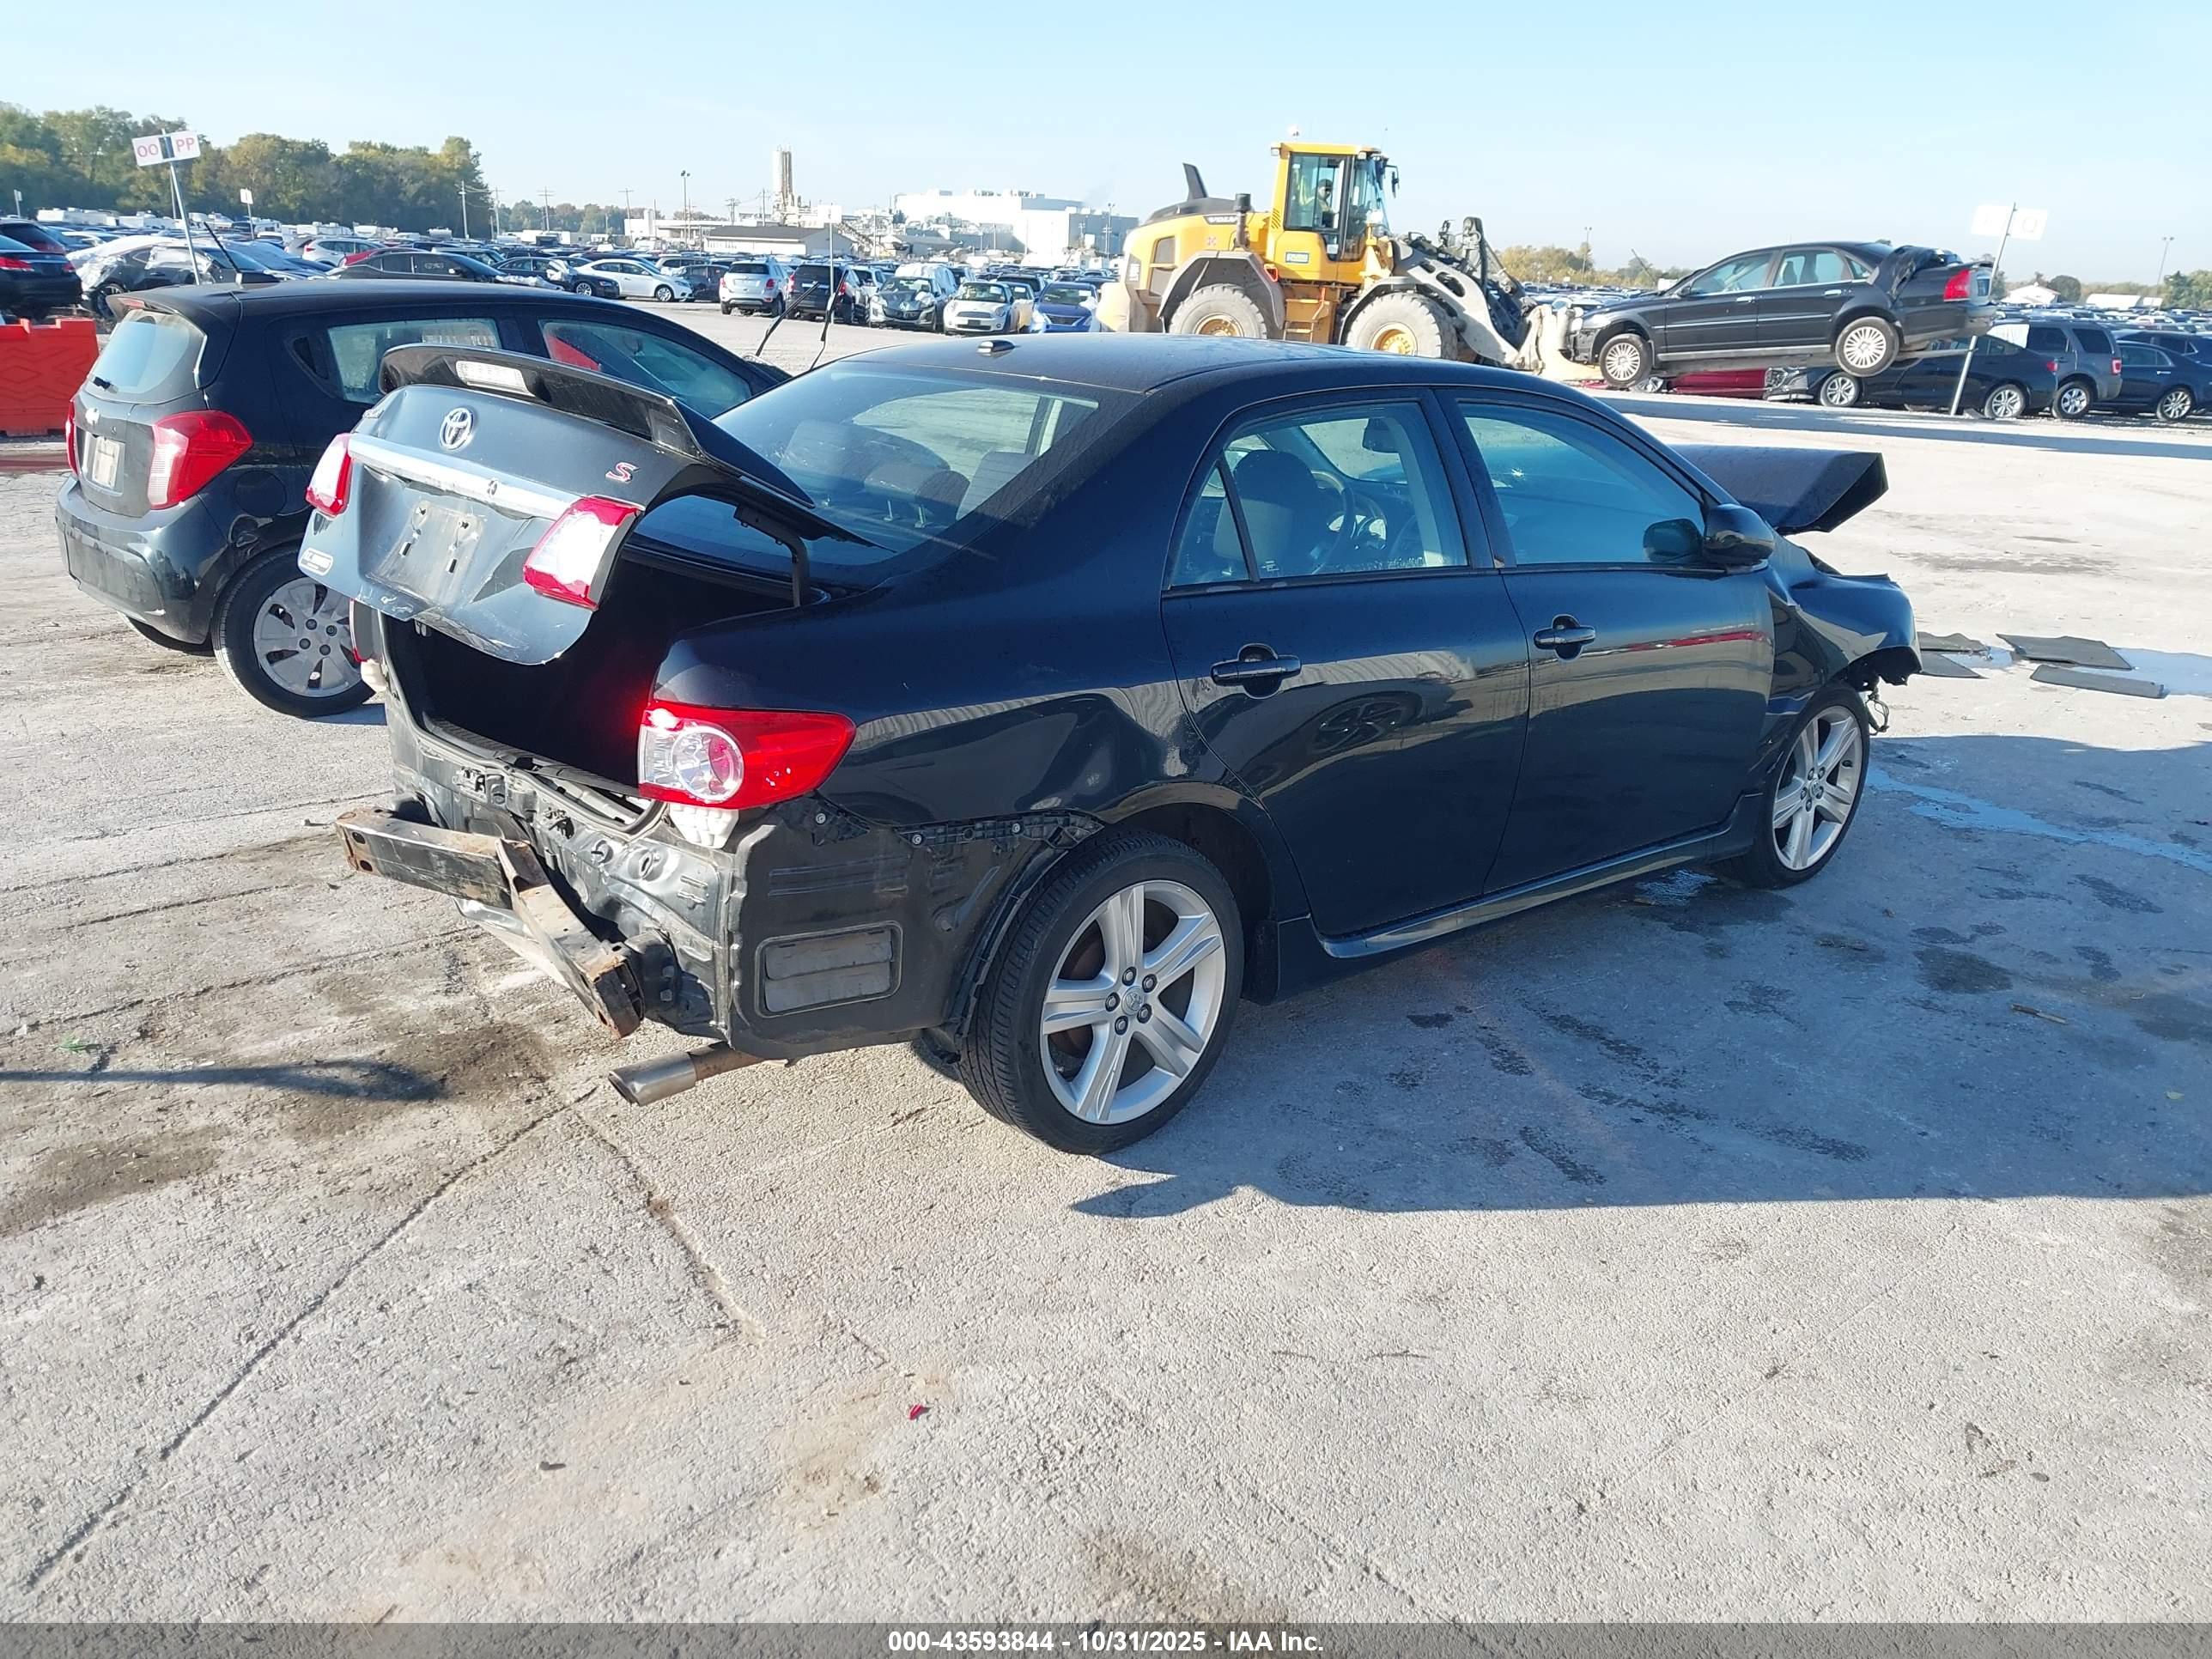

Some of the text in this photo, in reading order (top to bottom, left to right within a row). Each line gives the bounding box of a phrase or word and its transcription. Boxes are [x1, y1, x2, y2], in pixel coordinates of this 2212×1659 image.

[137, 137, 195, 157] OO PP
[605, 461, 640, 483] S
